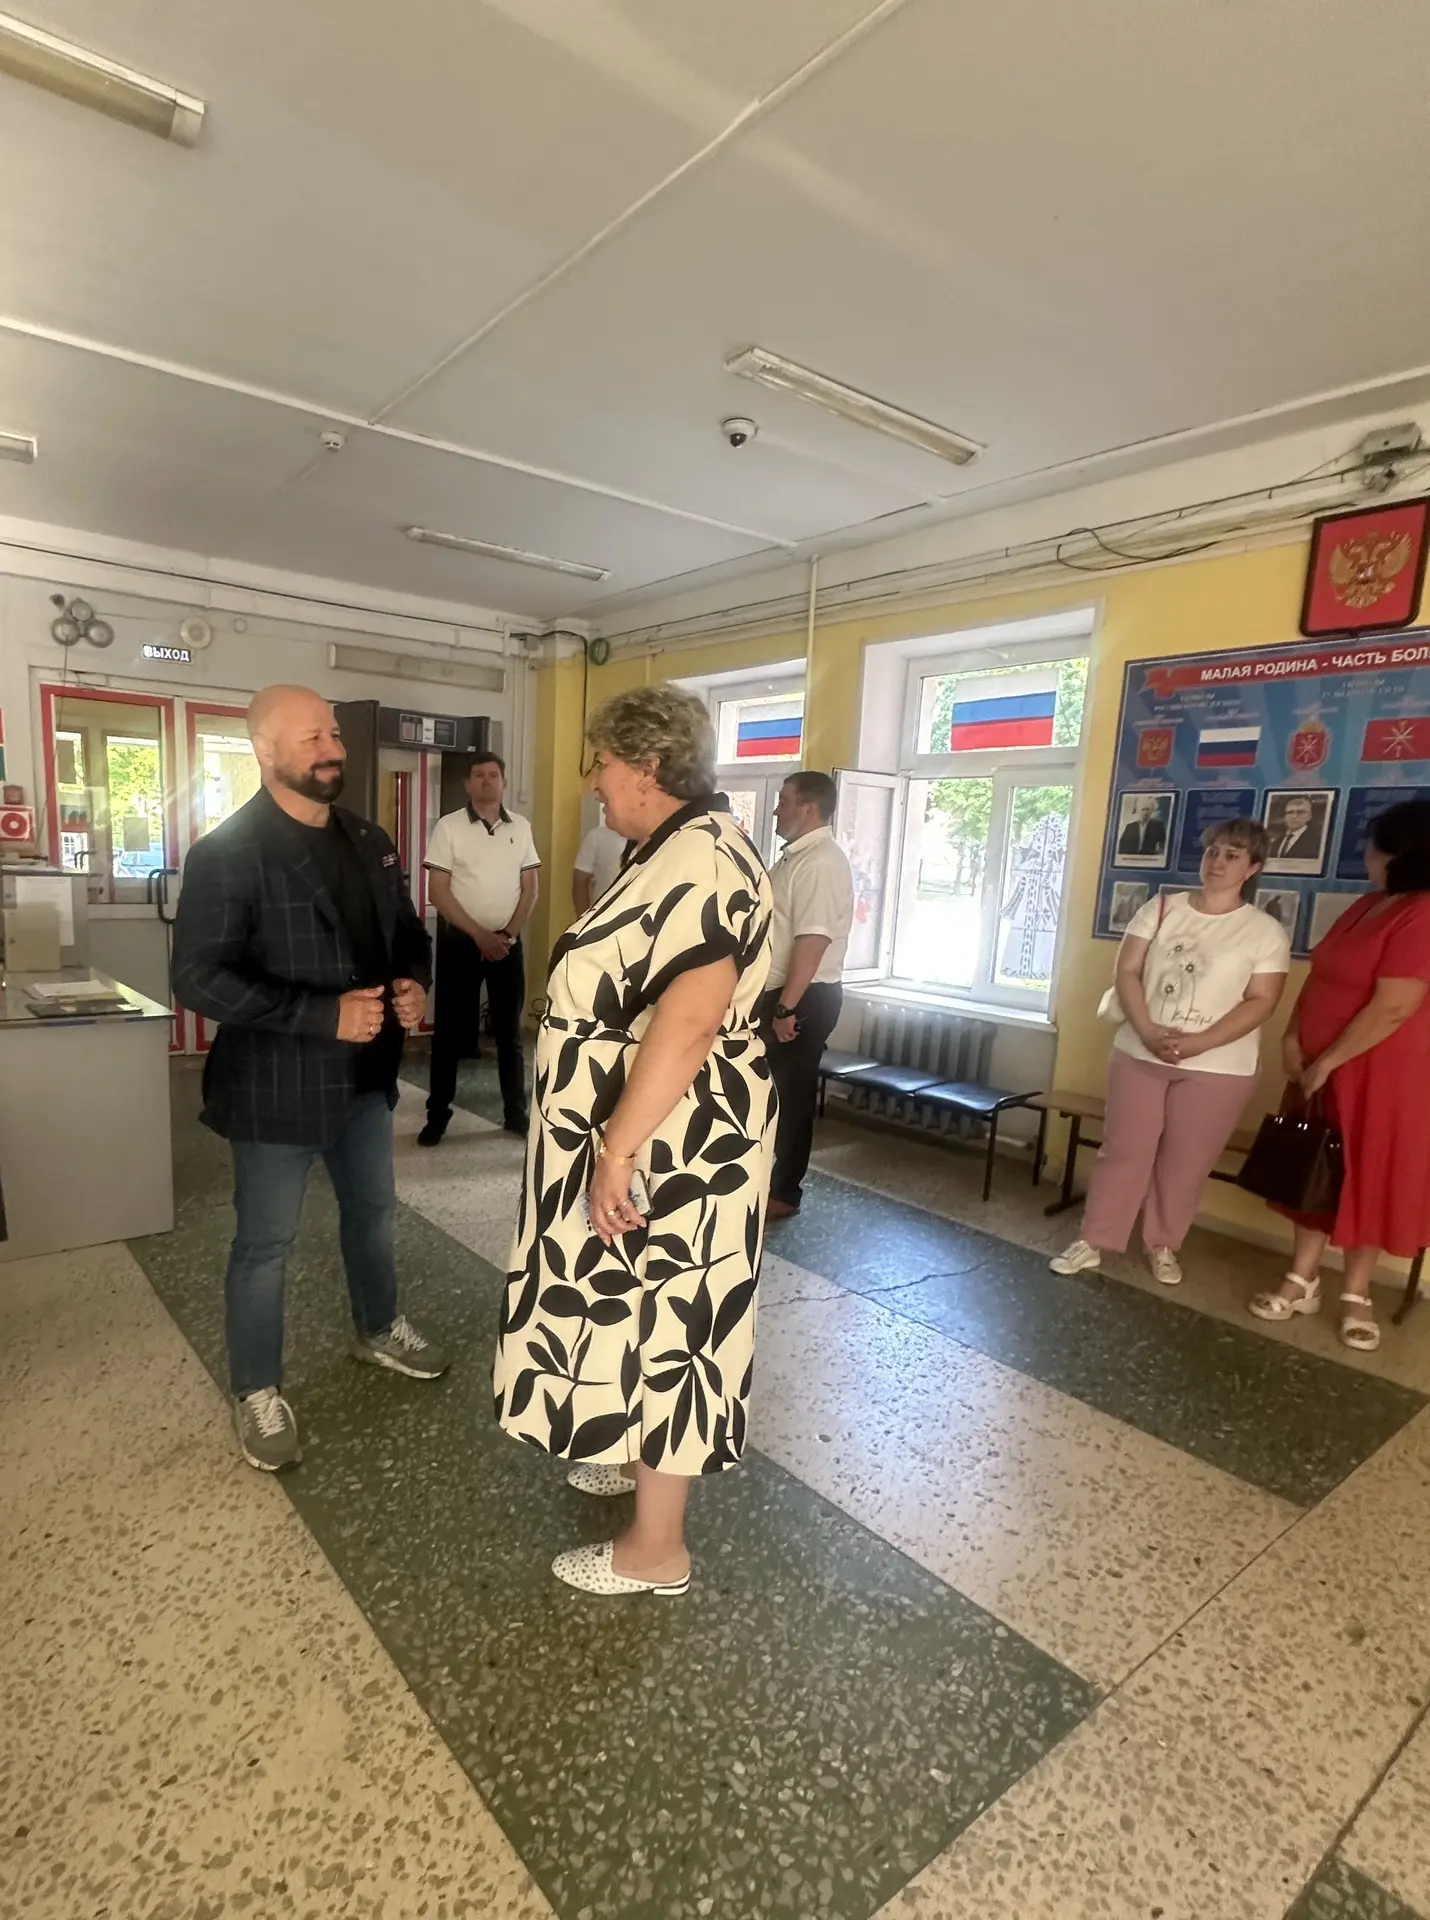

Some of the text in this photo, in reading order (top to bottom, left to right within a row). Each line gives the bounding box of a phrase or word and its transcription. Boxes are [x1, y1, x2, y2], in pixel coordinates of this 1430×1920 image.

[143, 645, 190, 662] ВЫХОД
[1201, 665, 1251, 680] МАЛАЯ
[1255, 658, 1317, 676] РОДИНА
[1332, 652, 1386, 667] ЧАСТЬ
[1391, 646, 1430, 662] БОЛ
